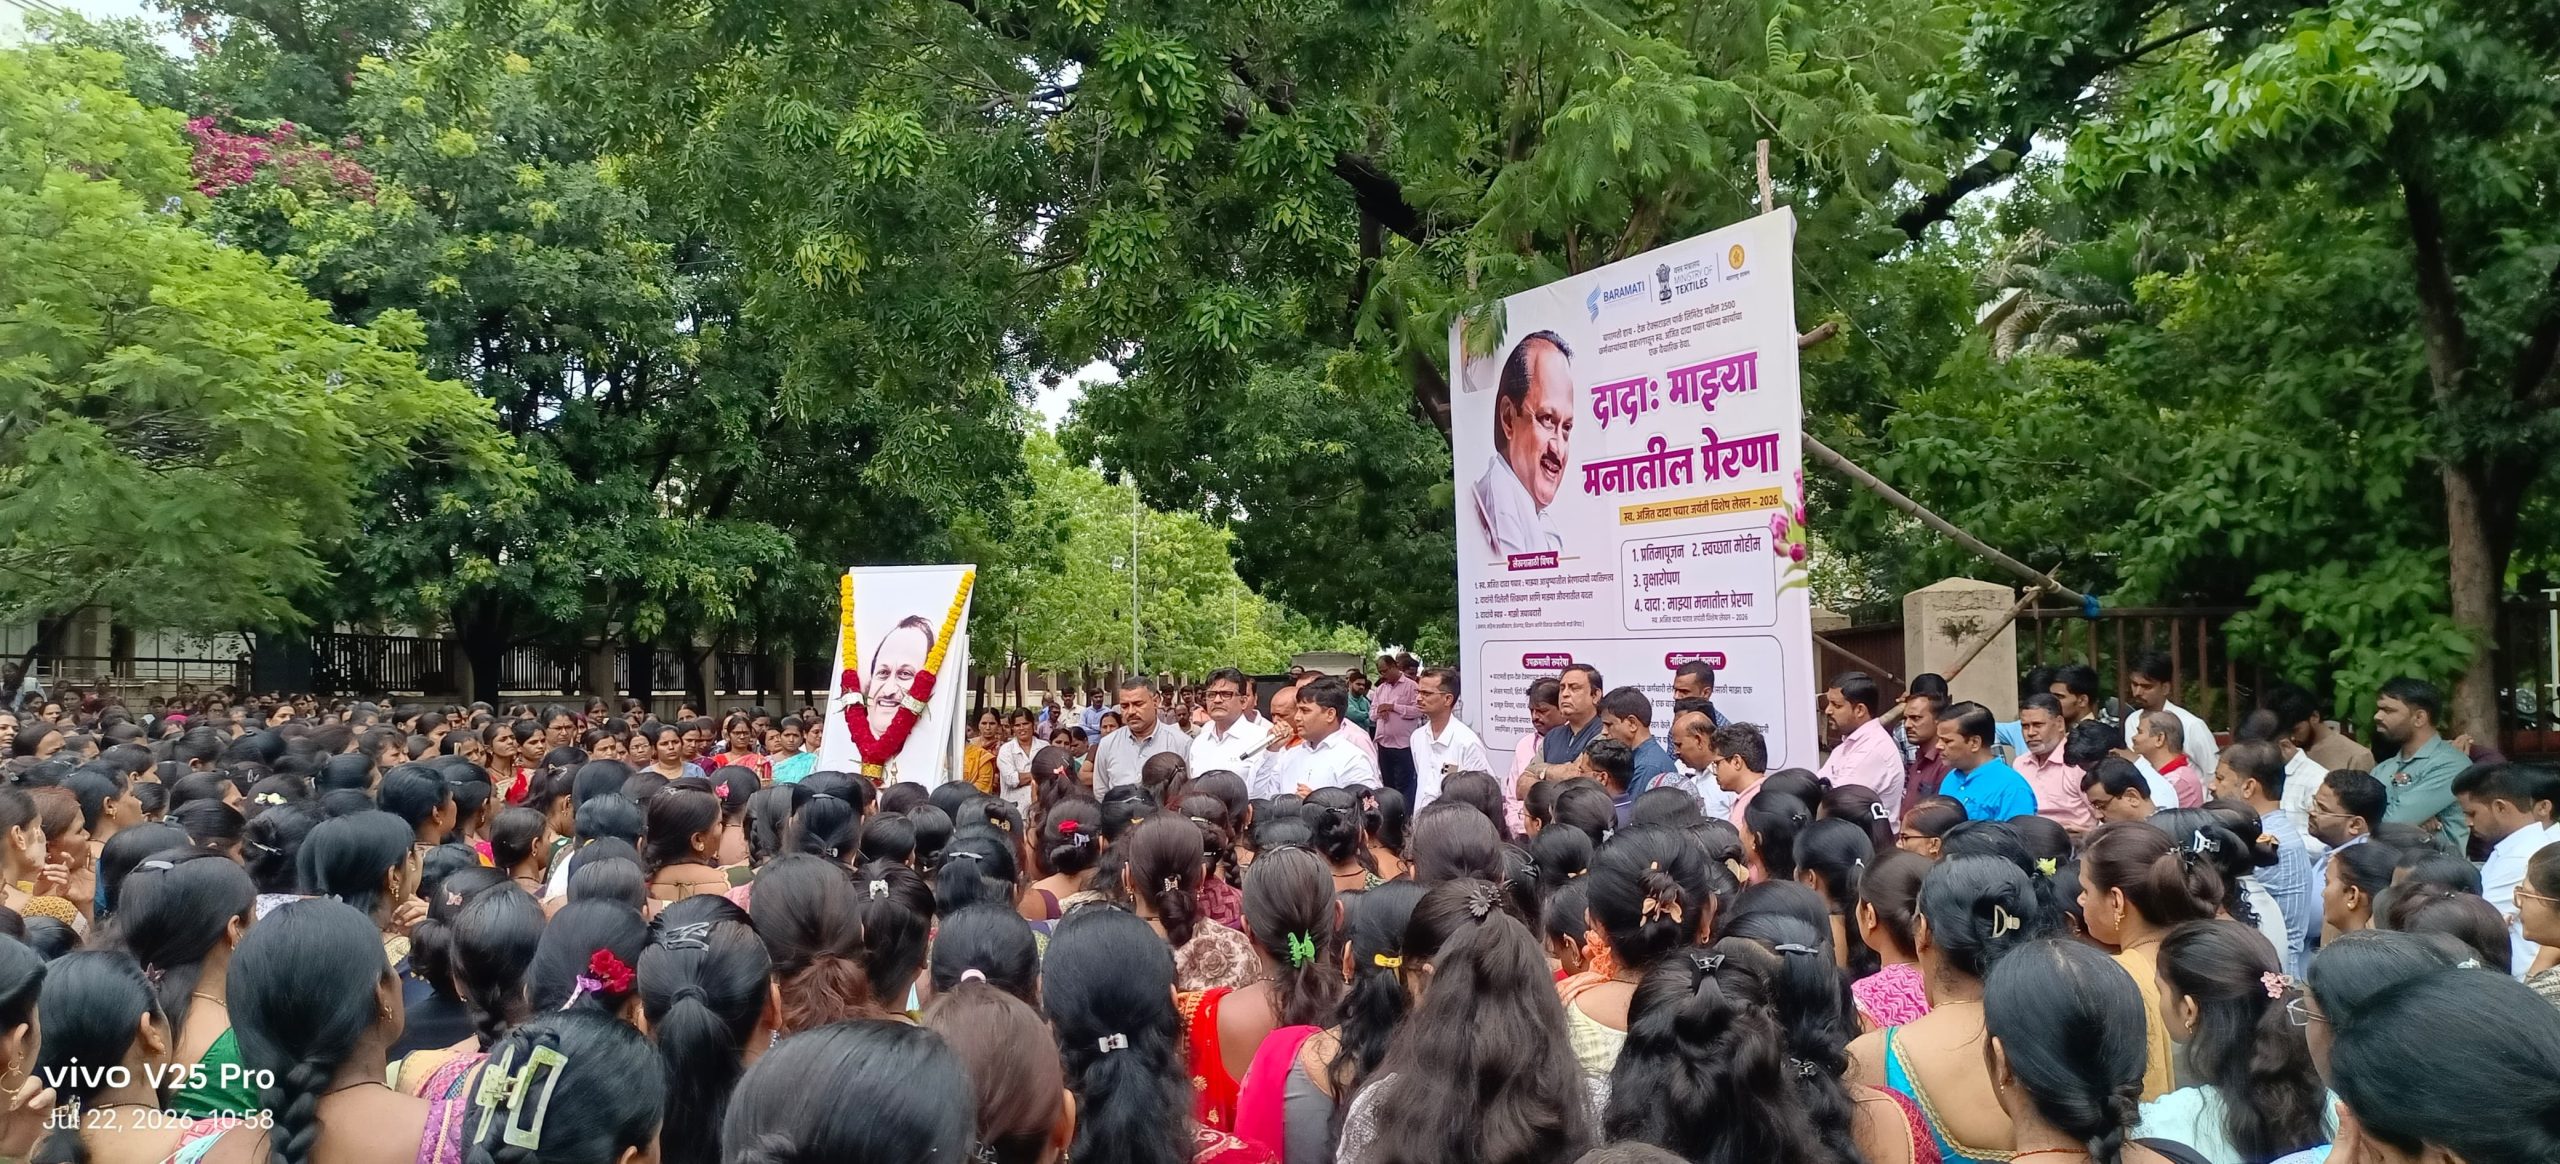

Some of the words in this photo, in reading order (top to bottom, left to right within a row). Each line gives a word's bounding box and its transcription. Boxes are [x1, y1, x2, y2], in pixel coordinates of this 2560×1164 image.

[1704, 264, 1713, 276] OF
[1603, 281, 1645, 302] BARAMATI
[1675, 277, 1709, 295] TEXTILES
[1721, 300, 1736, 311] 2500
[1680, 326, 1692, 335] दादा
[1667, 351, 1758, 412] माझ्या
[1582, 436, 1694, 497] मनातील
[1701, 427, 1780, 482] प्रेरणा
[1624, 512, 1635, 522] स्व.
[1636, 507, 1655, 520] अजित
[1657, 507, 1671, 518] दादा
[1674, 505, 1689, 516] पवार
[1691, 500, 1709, 514] जयंती
[1711, 498, 1730, 512] विशेष
[1732, 496, 1751, 510] लेखन
[1760, 494, 1779, 506] 2026
[1632, 548, 1639, 562] 1.
[1640, 544, 1684, 564] प्रतिमापूजन
[1692, 543, 1700, 557] 2.
[1702, 540, 1732, 556] स्वच्छता
[1734, 533, 1761, 553] मोहीम
[1633, 574, 1641, 588] 3.
[1642, 568, 1680, 592] वृक्षारोपण
[1634, 598, 1643, 612] 4.
[1644, 597, 1660, 612] दादा
[1667, 596, 1692, 612] माझ्या
[1694, 590, 1728, 610] मनातील
[1730, 589, 1754, 608] प्रेरणा
[1743, 686, 1753, 694] एक
